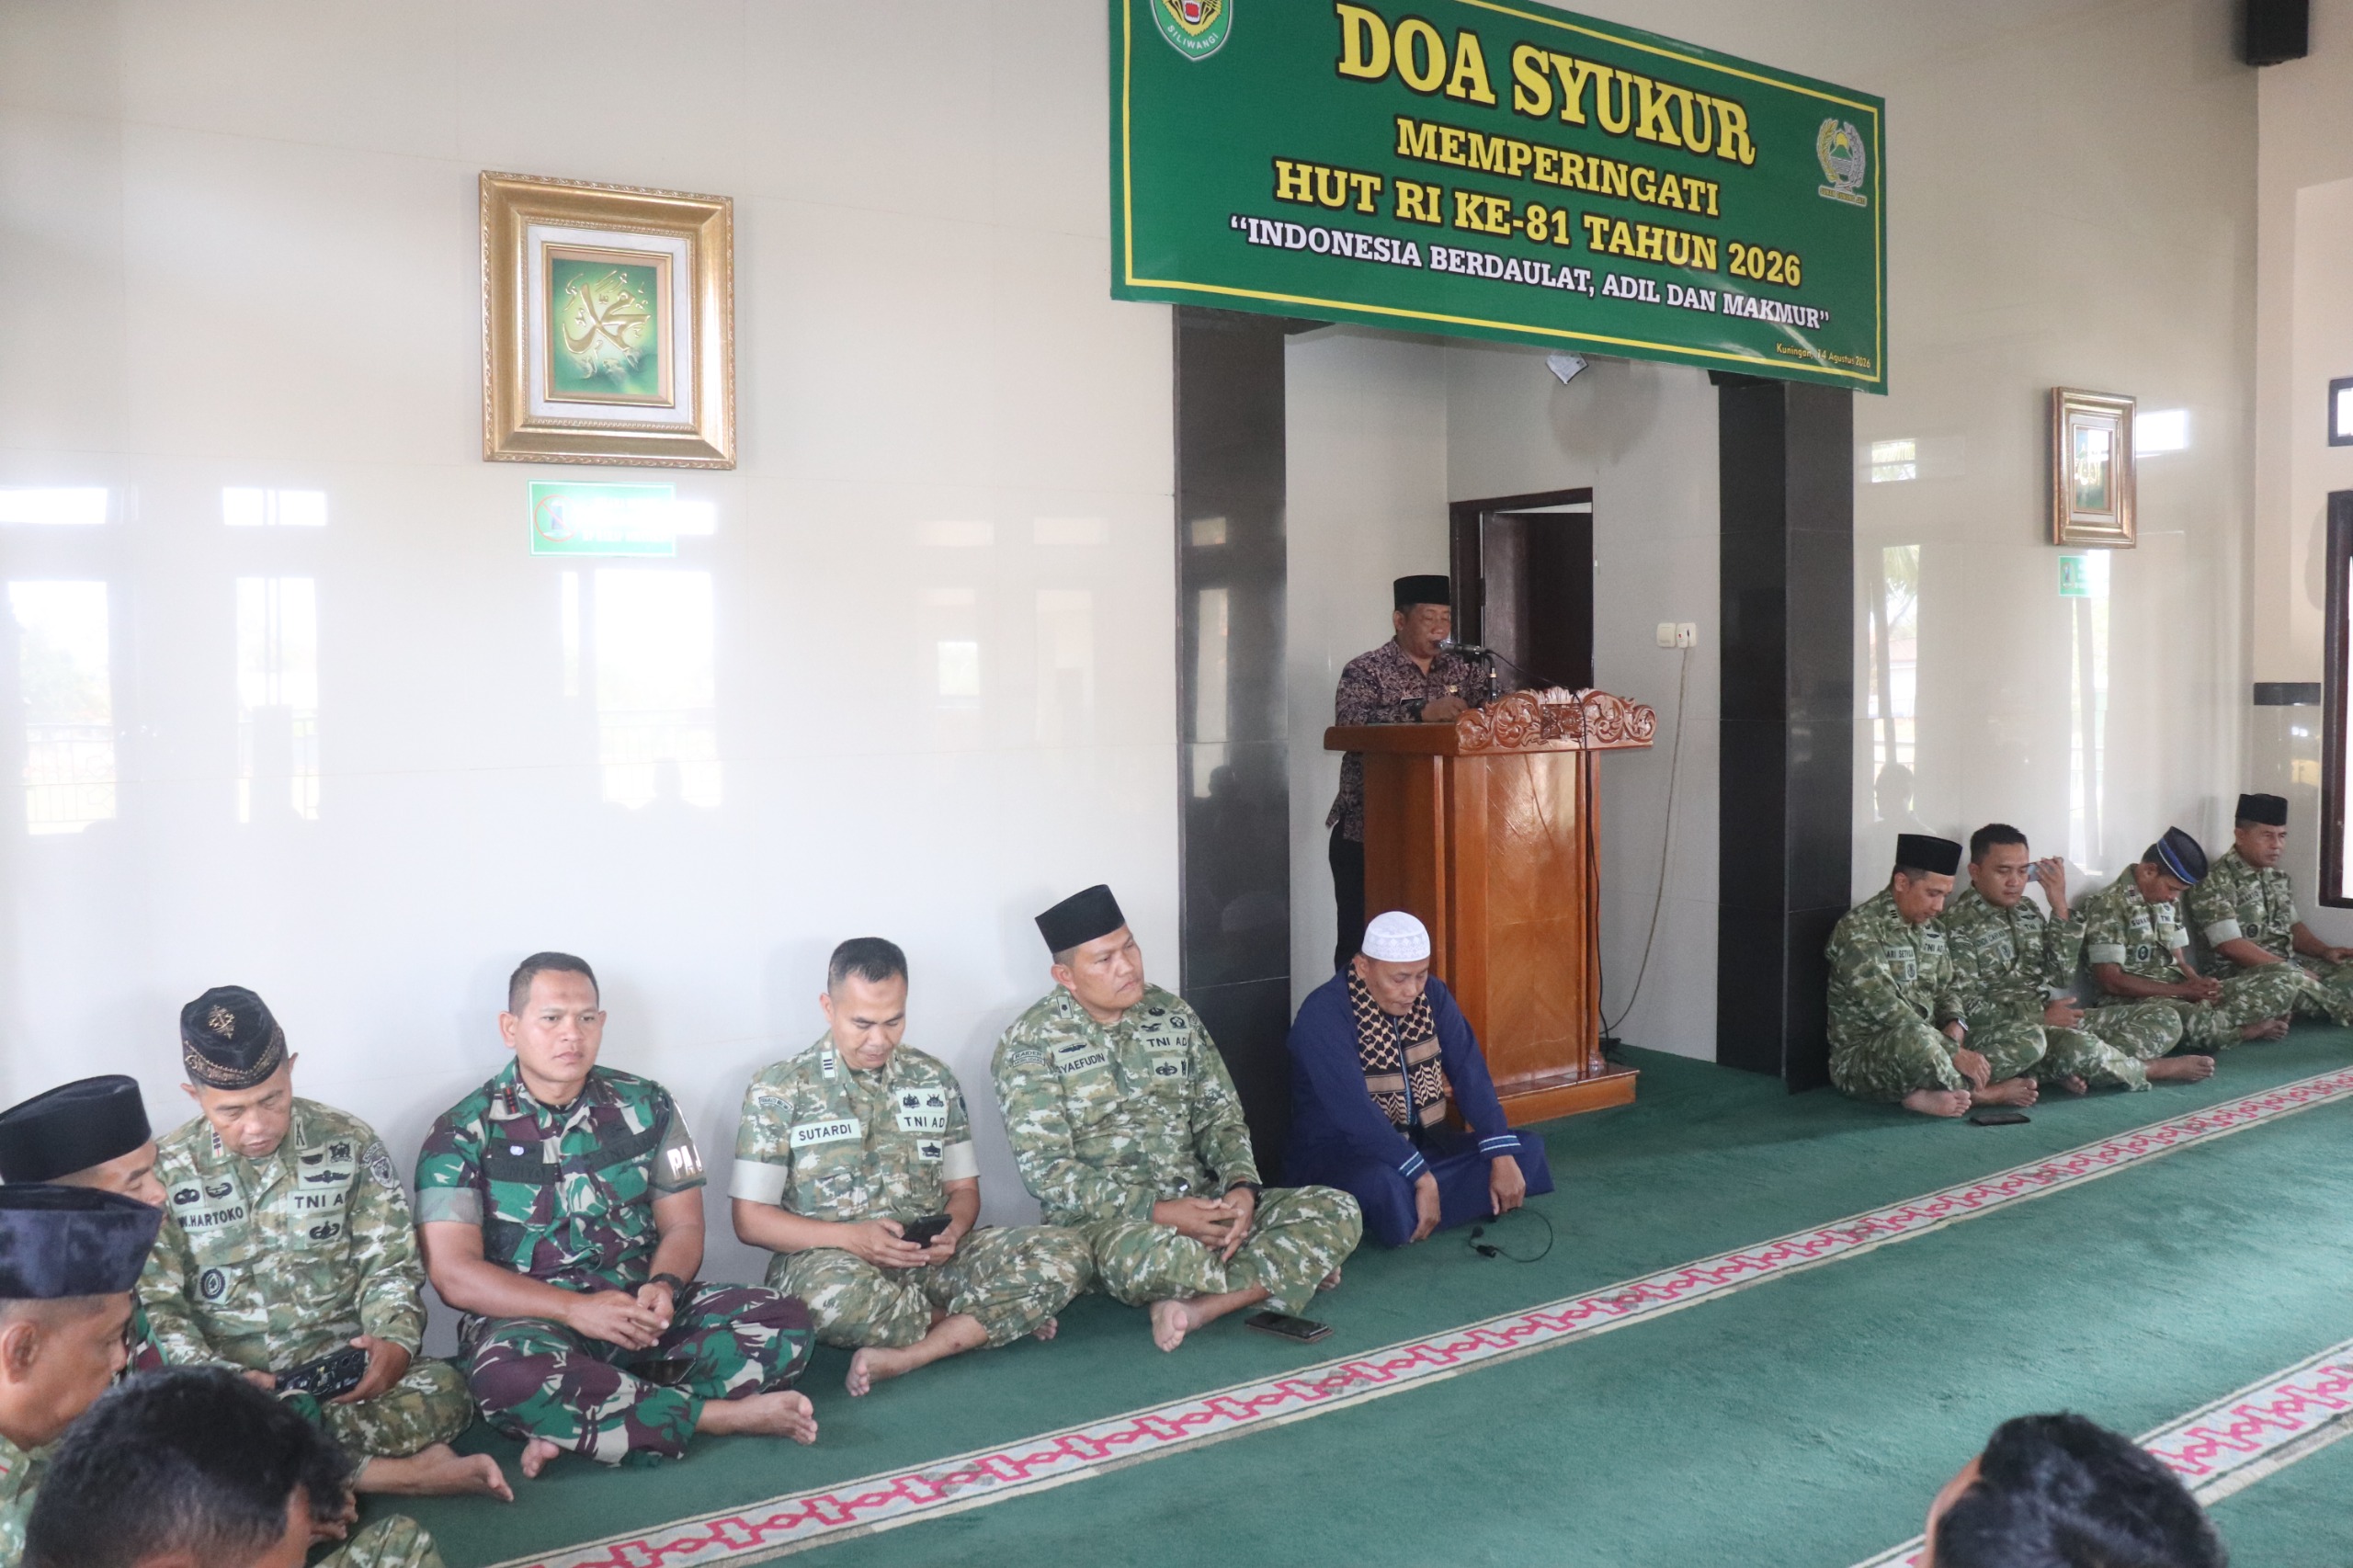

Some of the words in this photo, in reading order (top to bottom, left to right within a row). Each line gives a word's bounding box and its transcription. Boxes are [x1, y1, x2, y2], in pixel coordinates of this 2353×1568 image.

[1167, 25, 1219, 50] SILIWANGI
[1336, 2, 1496, 106] DOA
[1511, 44, 1756, 165] SYUKUR
[1396, 117, 1720, 217] MEMPERINGATI
[1275, 159, 1381, 213] HUT
[1394, 179, 1442, 224] RI
[1453, 190, 1570, 246] KE-81
[1583, 214, 1718, 271] TAHUN
[1727, 242, 1802, 287] 2026
[1429, 244, 1596, 299] BERDAULAT,
[1601, 273, 1661, 304] ADIL
[1665, 282, 1717, 312] DAN
[1776, 343, 1813, 359] Kuningan,
[1828, 352, 1855, 364] Agustus
[1855, 356, 1871, 369] 2026
[1146, 1036, 1171, 1048] TNI
[1176, 1036, 1188, 1047] AD
[1015, 1051, 1042, 1059] RAIDER
[798, 1123, 852, 1142] SUTARDI
[904, 1116, 927, 1128] TNI
[931, 1116, 946, 1129] AD
[294, 1194, 326, 1210] TNI
